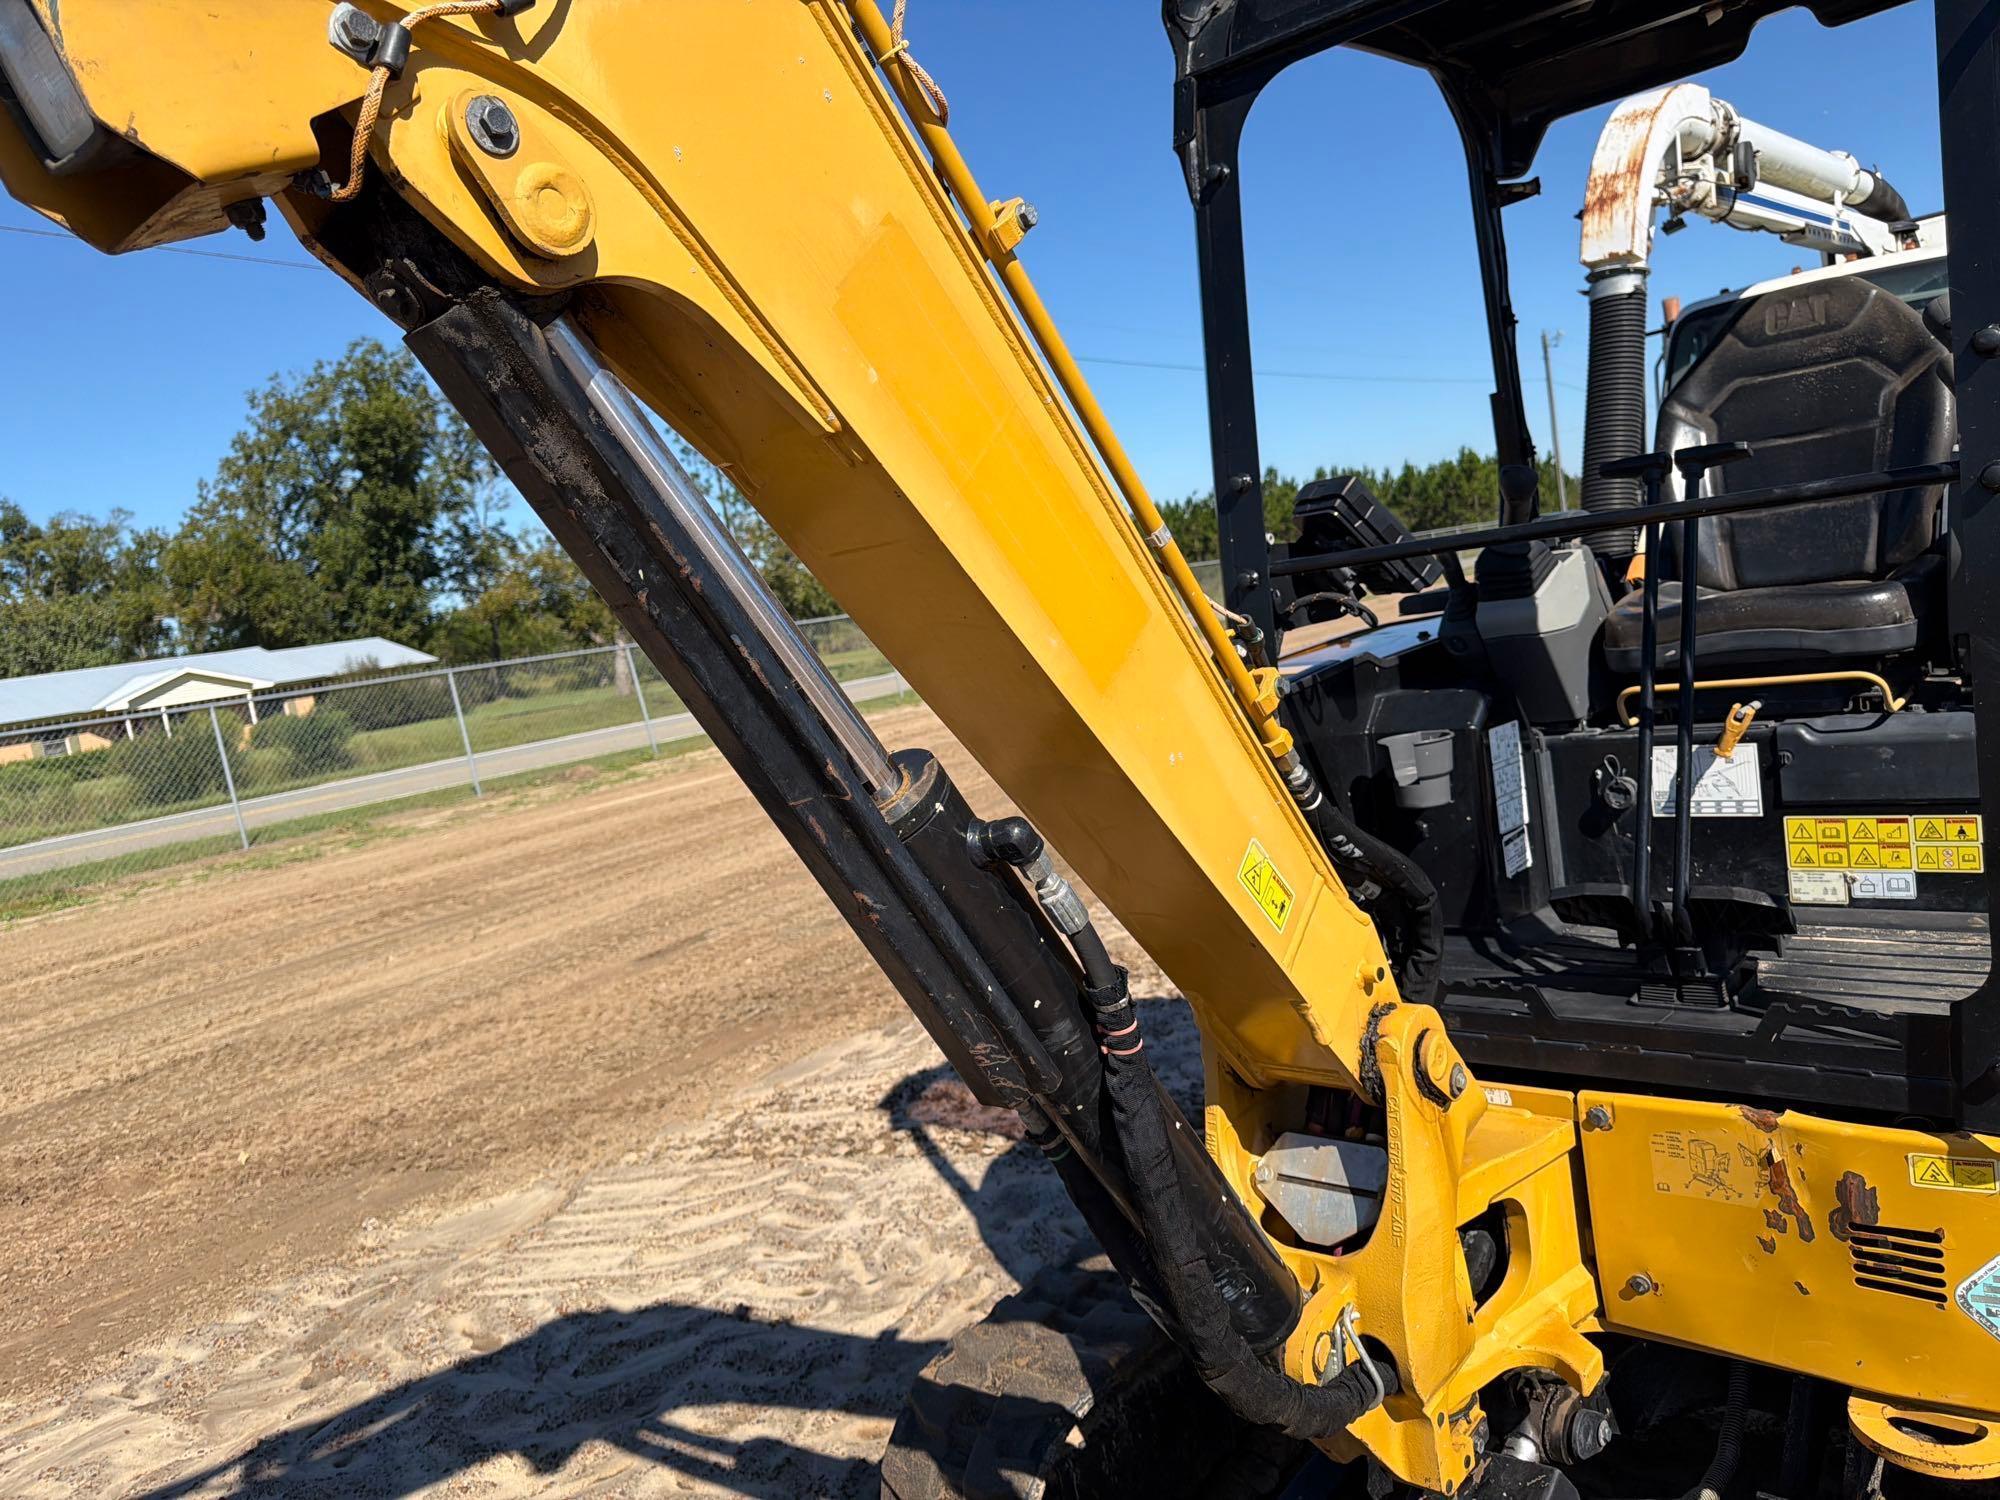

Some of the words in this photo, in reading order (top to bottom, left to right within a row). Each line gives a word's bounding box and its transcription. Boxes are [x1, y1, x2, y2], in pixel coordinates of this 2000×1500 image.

[1765, 294, 1830, 336] CAT
[1331, 834, 1364, 857] CAT
[1387, 1095, 1400, 1122] CAT
